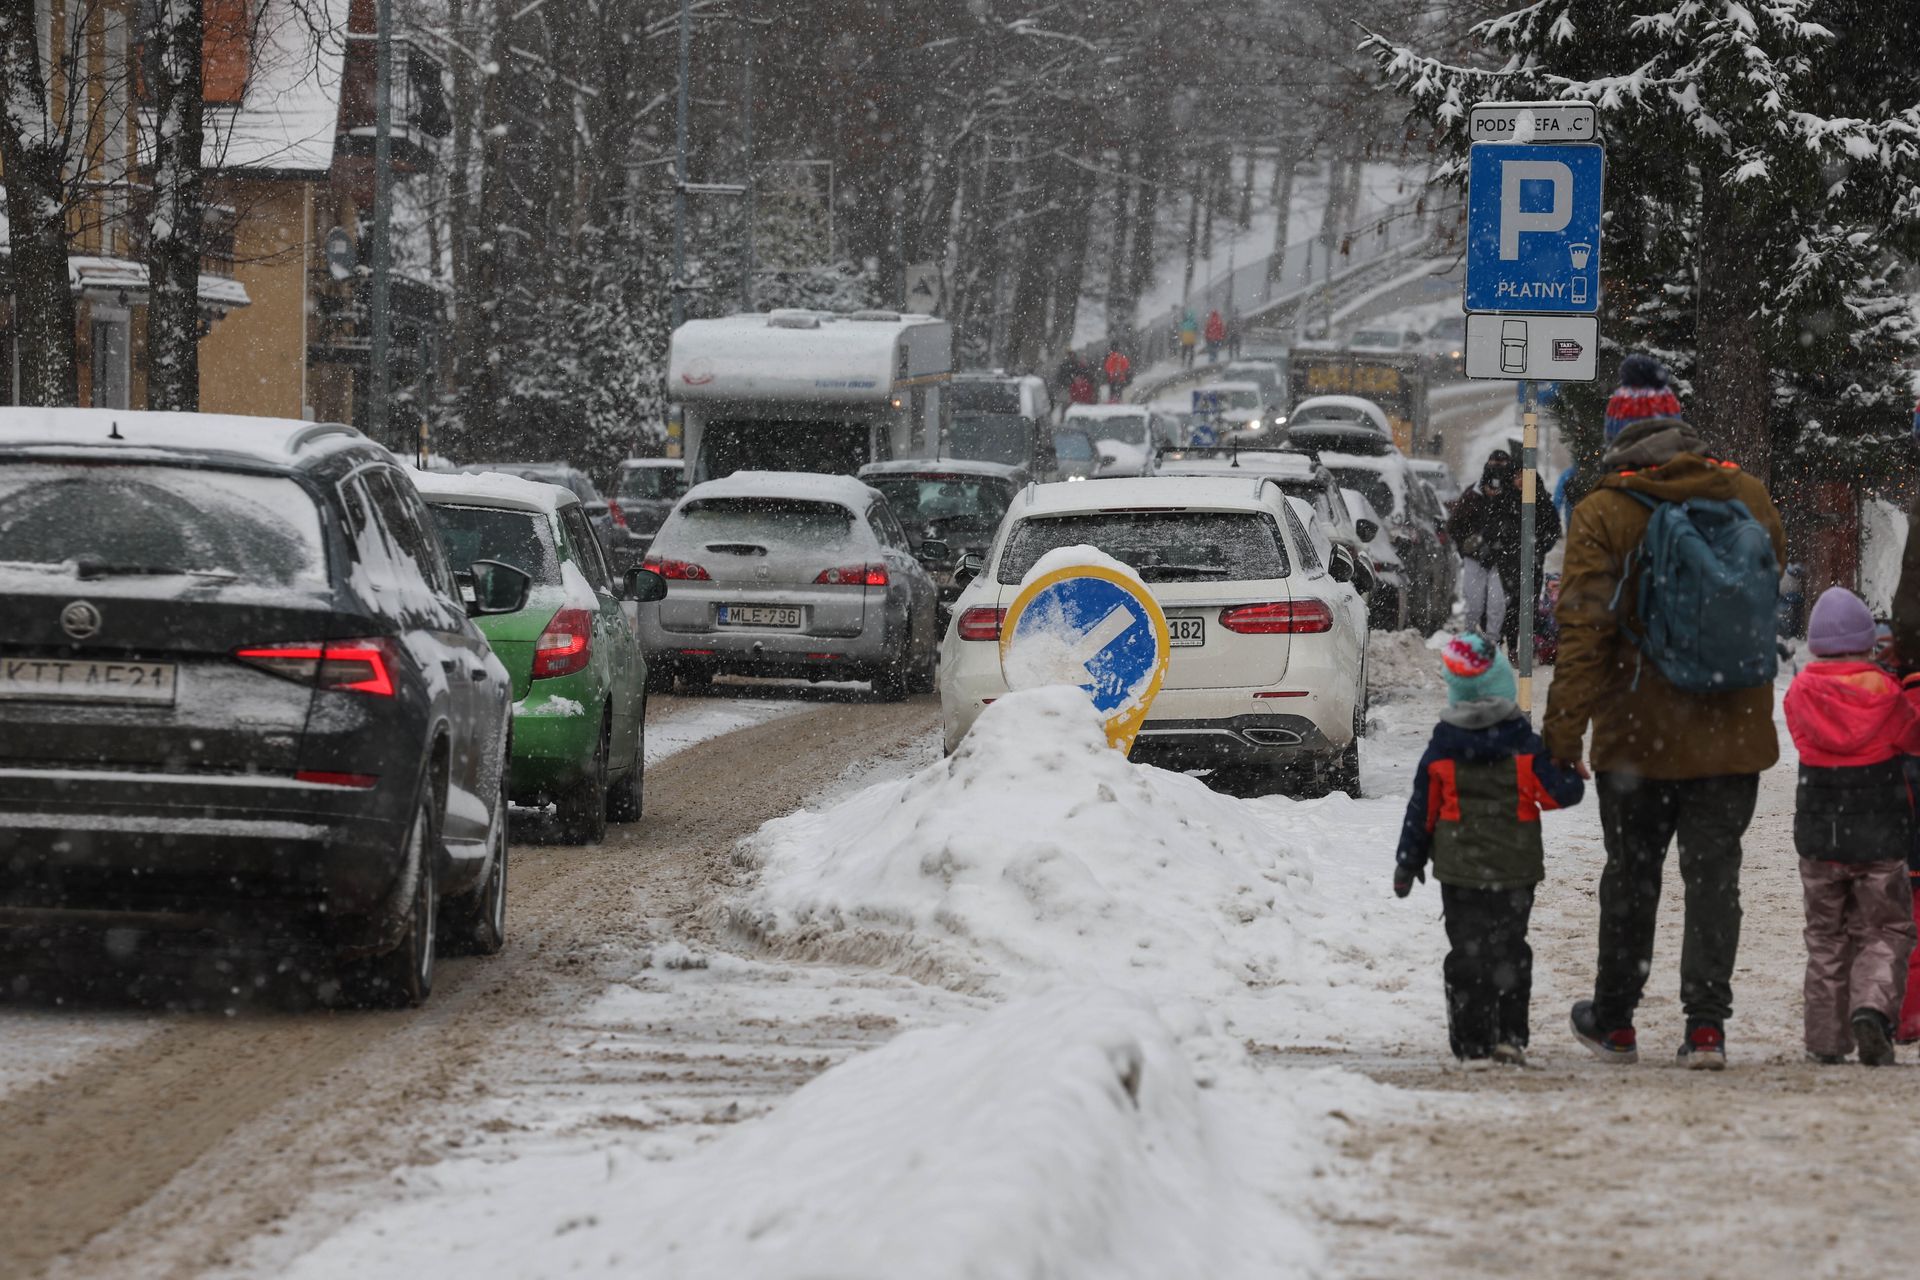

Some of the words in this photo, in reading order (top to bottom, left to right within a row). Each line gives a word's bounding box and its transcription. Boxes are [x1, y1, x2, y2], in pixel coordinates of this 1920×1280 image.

[1476, 118, 1560, 132] PODSEFA
[1500, 160, 1573, 261] P
[1498, 281, 1566, 298] PŁATNY
